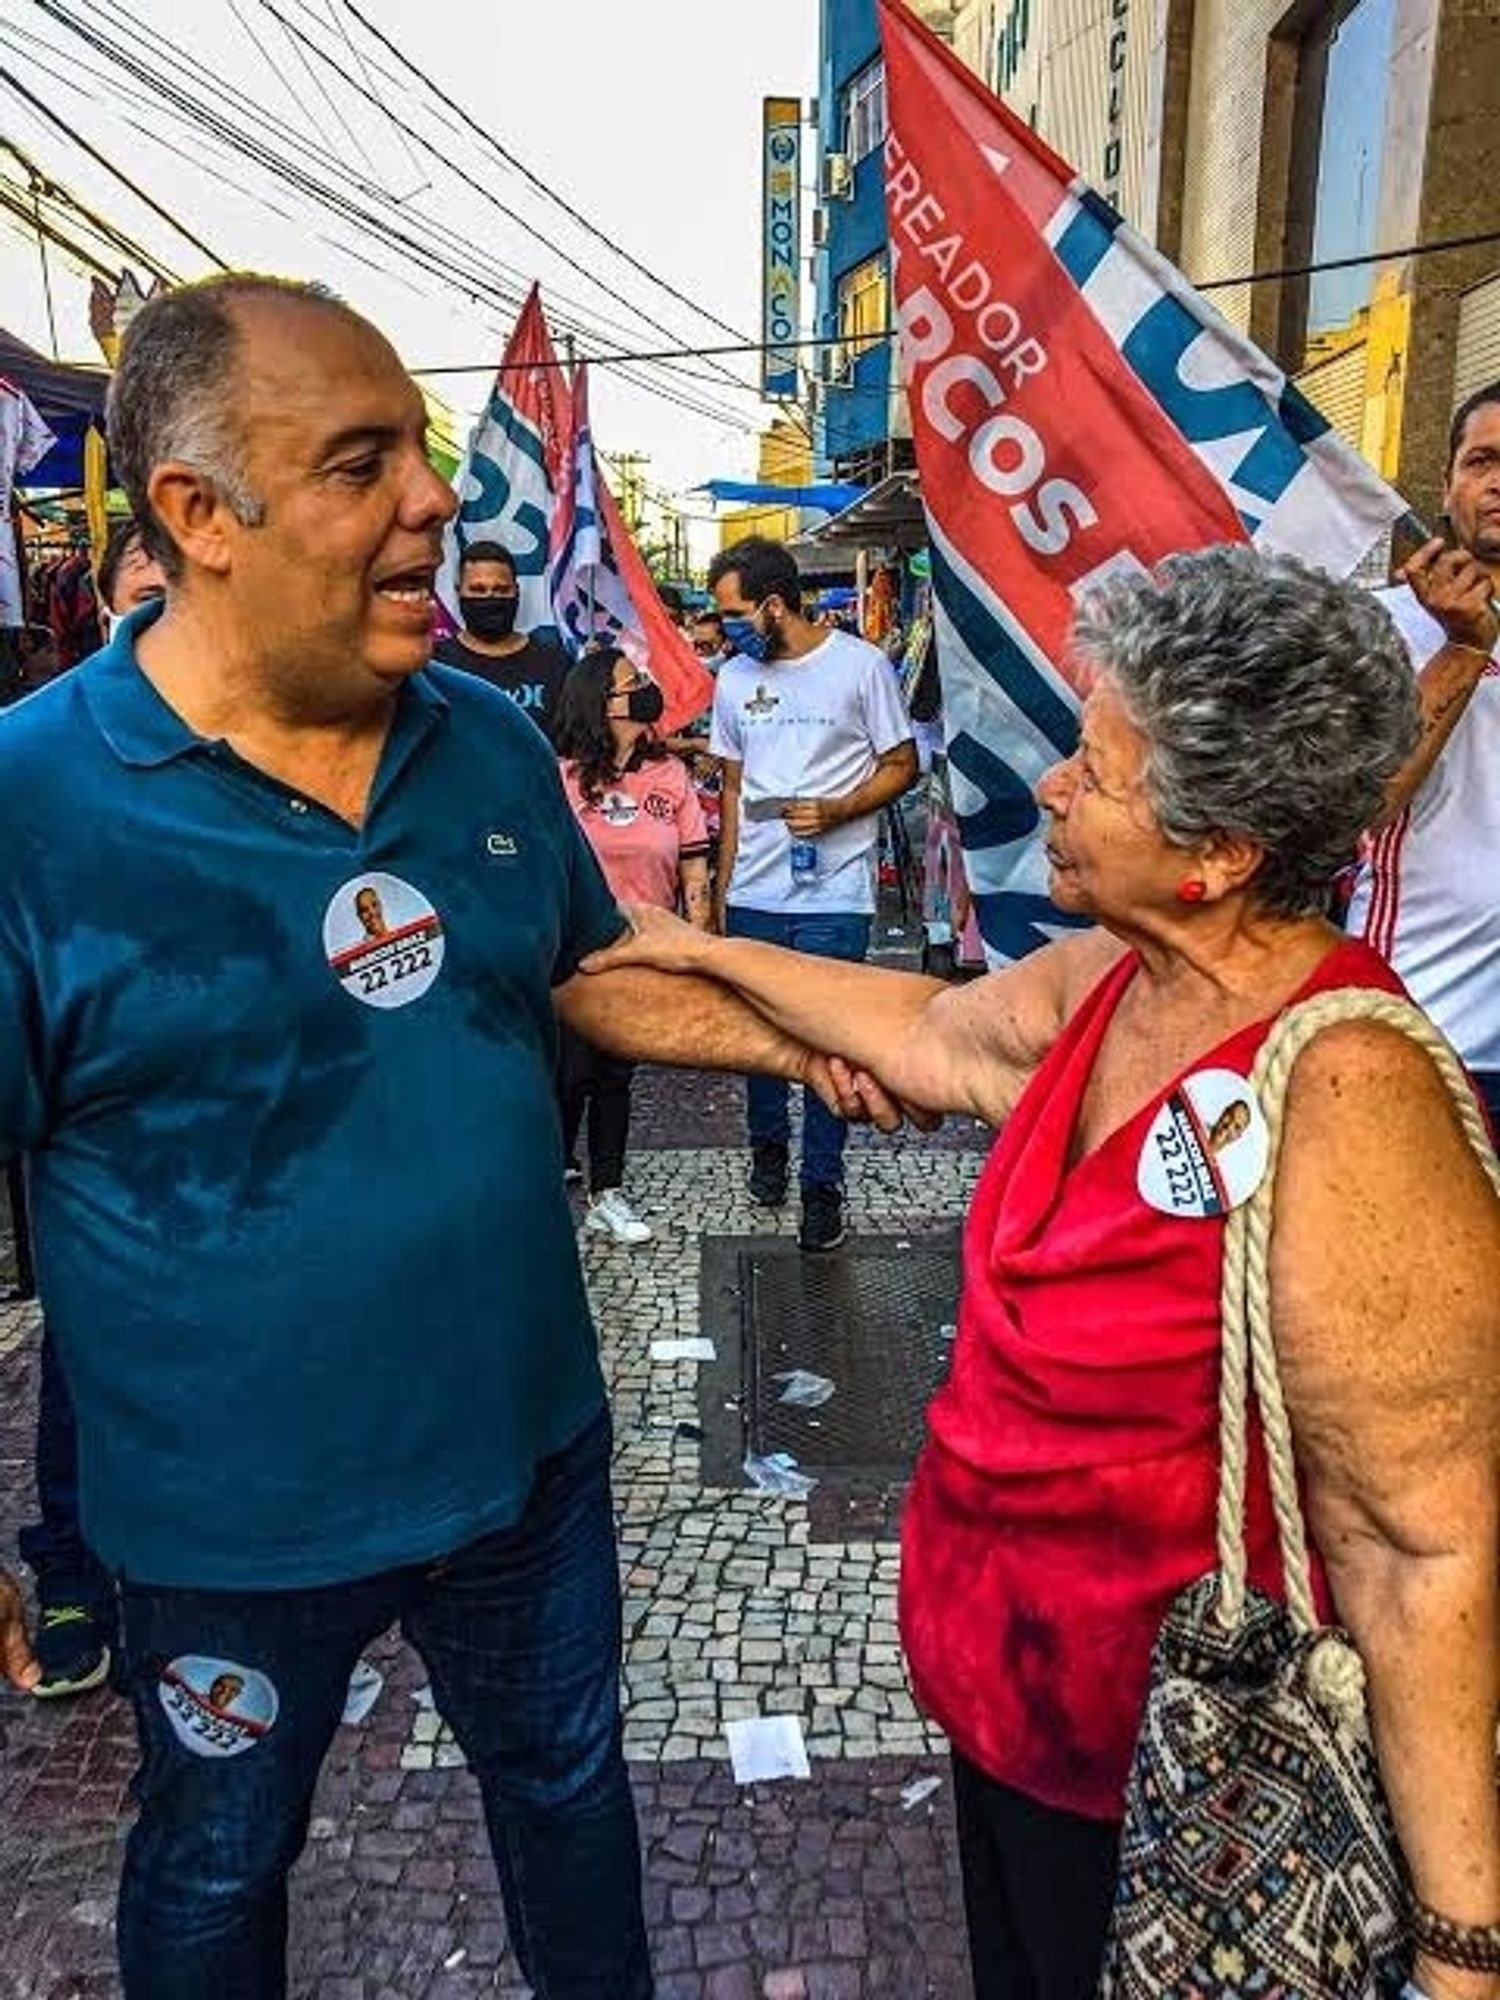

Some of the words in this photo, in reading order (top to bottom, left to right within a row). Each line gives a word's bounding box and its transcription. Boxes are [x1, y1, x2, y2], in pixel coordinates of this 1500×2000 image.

[892, 250, 1099, 556] RCOS
[359, 965, 389, 994] 22
[390, 946, 432, 980] 222
[1155, 1126, 1182, 1161] 22
[1165, 1162, 1198, 1208] 222
